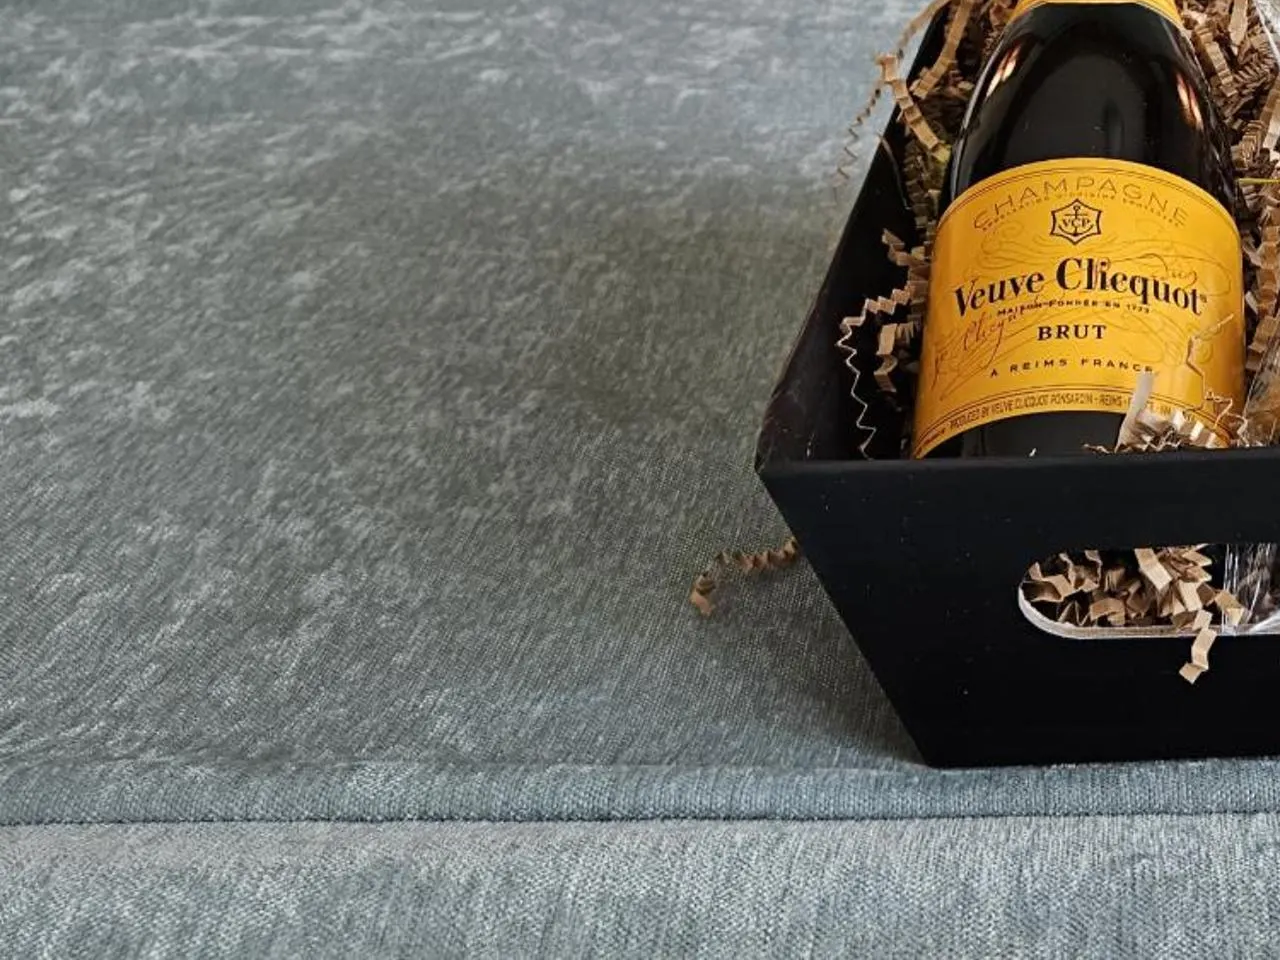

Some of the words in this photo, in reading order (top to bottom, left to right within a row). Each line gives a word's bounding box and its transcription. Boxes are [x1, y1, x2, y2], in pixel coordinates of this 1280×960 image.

[974, 176, 1189, 229] CHAMPAGNE
[954, 271, 1044, 317] Veuve
[1056, 257, 1202, 317] Clicquot
[1037, 324, 1107, 341] BRUT
[1010, 358, 1067, 373] REIMS
